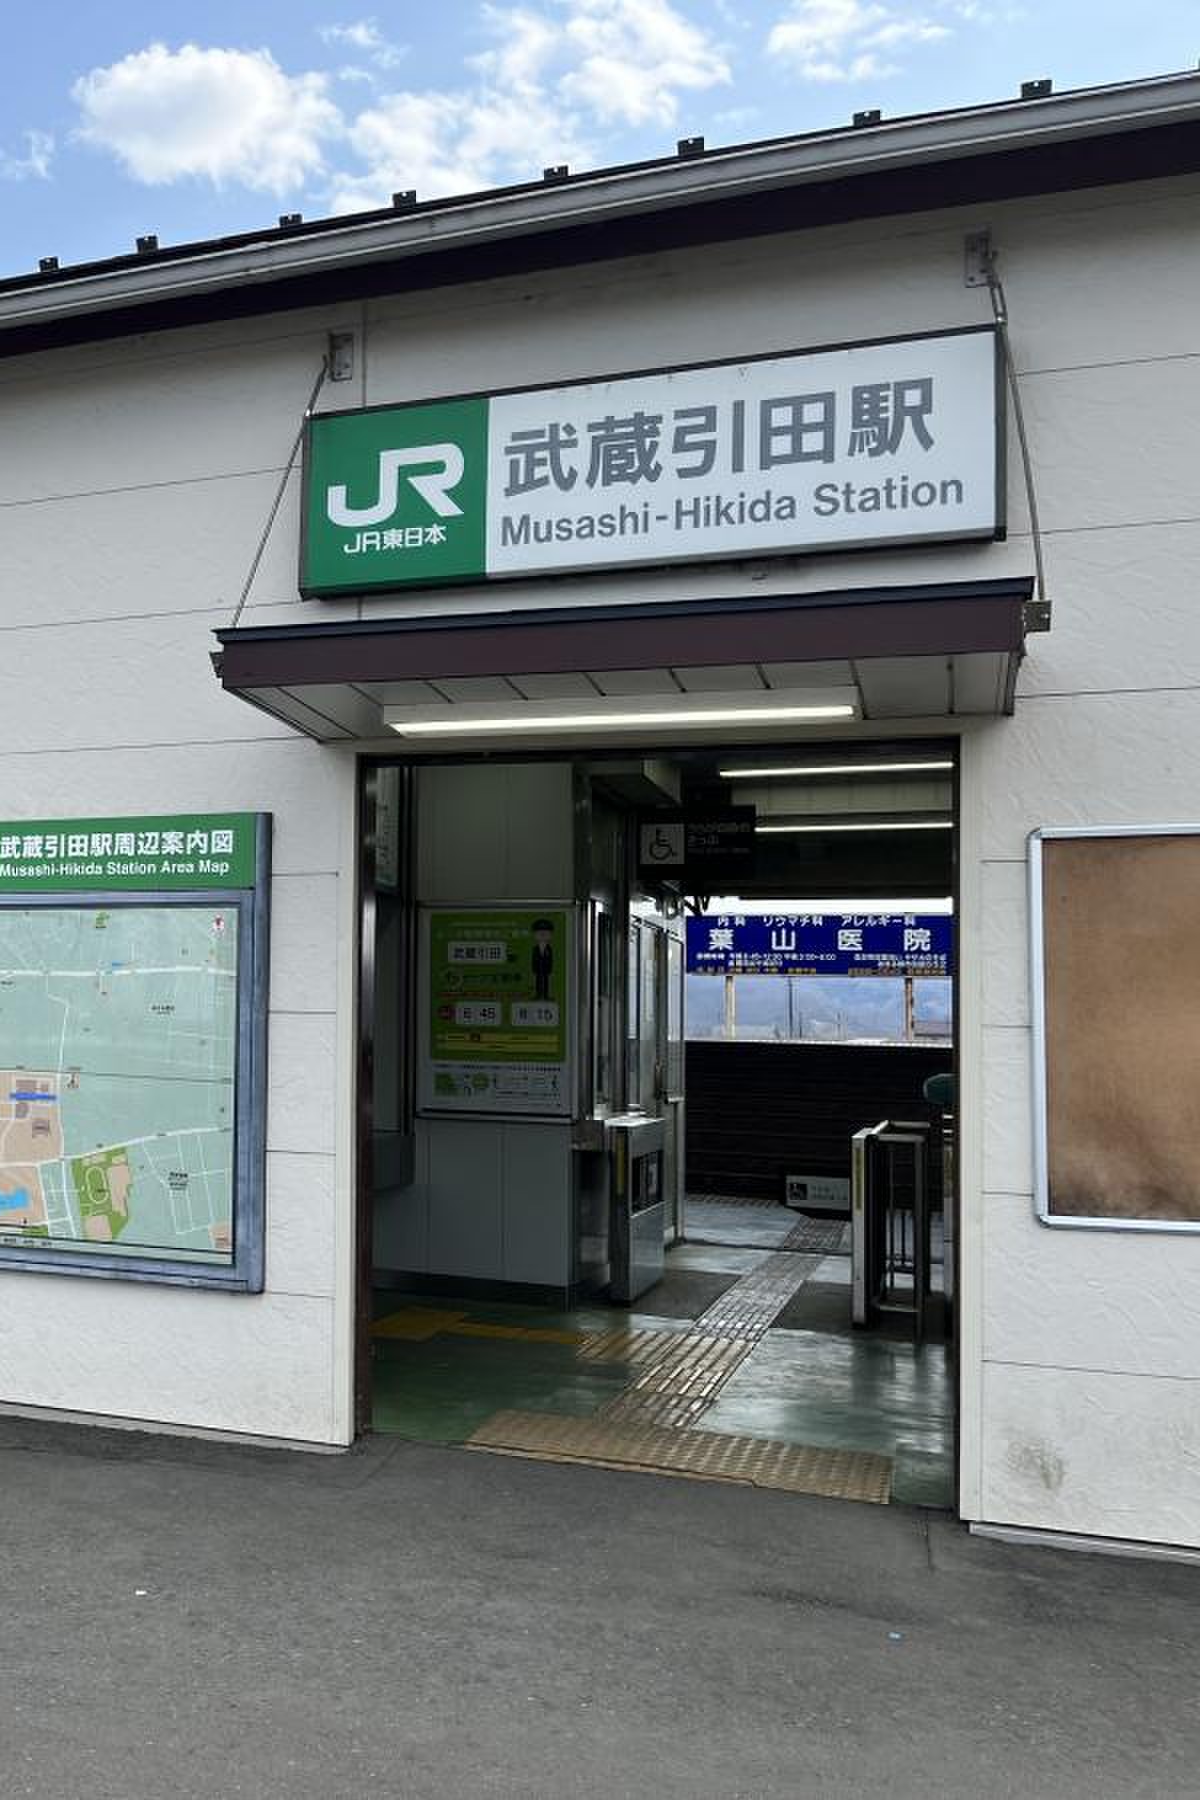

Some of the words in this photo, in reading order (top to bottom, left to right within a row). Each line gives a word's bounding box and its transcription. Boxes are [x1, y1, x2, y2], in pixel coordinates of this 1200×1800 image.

[503, 376, 936, 498] 武蔵引田駅
[327, 443, 465, 527] JR
[501, 482, 796, 548] Musashi-Hikida
[813, 474, 964, 517] Station
[343, 523, 447, 553] JR東日本
[0, 830, 234, 859] 武蔵引田駅周辺案内図
[0, 861, 103, 878] Musashi-Hikida
[107, 861, 156, 875] Station
[160, 861, 194, 874] Area
[199, 860, 229, 876] Map
